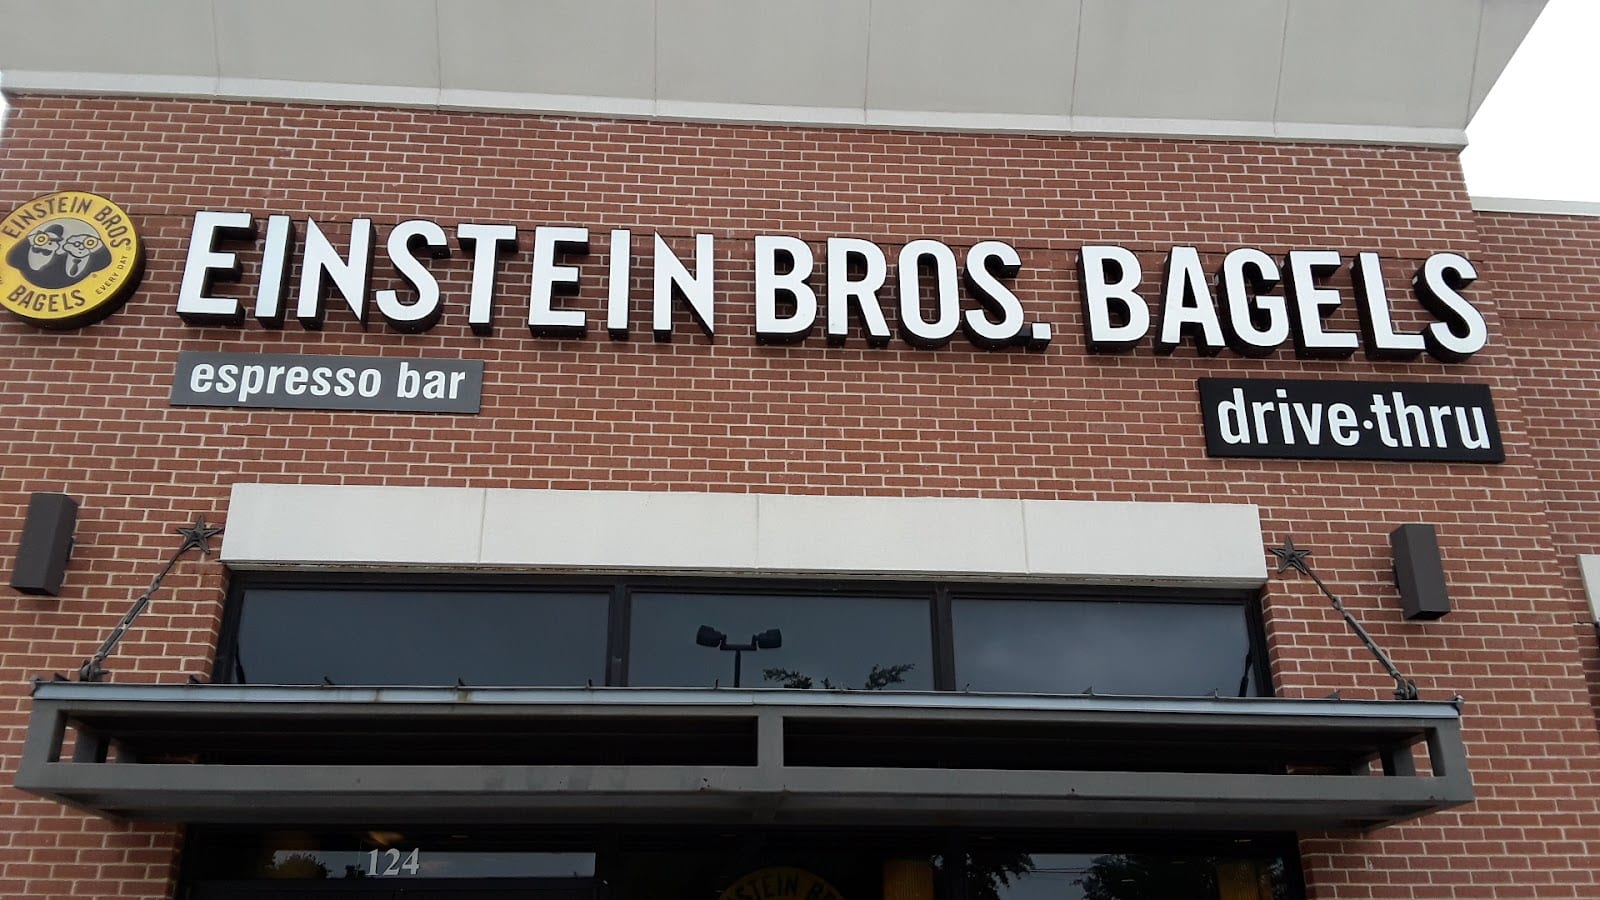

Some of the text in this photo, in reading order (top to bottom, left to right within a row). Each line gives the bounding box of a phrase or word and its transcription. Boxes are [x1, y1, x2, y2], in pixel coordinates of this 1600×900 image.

[1, 196, 131, 248] EINSTEIN BROS
[95, 255, 128, 295] EVERY DAY
[176, 210, 1489, 358] EINSTEIN BROS. BAGELS
[6, 285, 86, 312] BAGELS
[189, 361, 466, 402] espresso bar
[366, 847, 421, 877] 124
